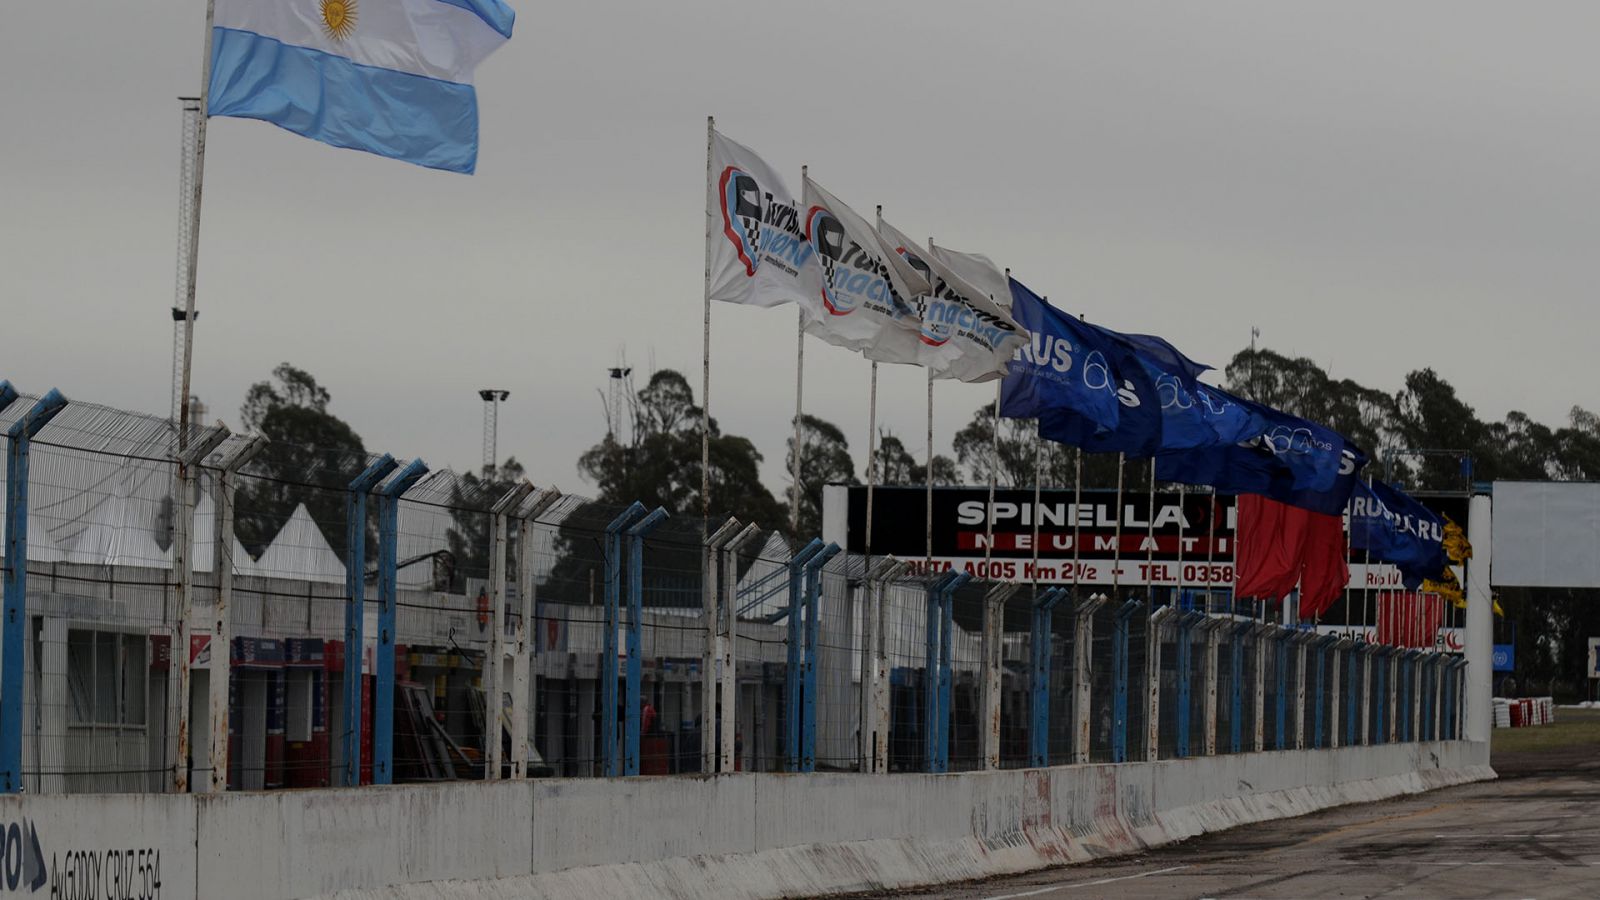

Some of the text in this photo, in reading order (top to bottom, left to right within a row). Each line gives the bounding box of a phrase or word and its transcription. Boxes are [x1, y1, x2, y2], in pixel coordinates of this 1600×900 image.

[957, 500, 1191, 529] SPINELLA
[974, 533, 1228, 553] NEUMATI
[1024, 562, 1056, 580] Km
[1138, 564, 1177, 581] TEL.
[1183, 565, 1233, 583] 0358
[105, 850, 135, 900] CRUZ
[138, 848, 161, 900] 564
